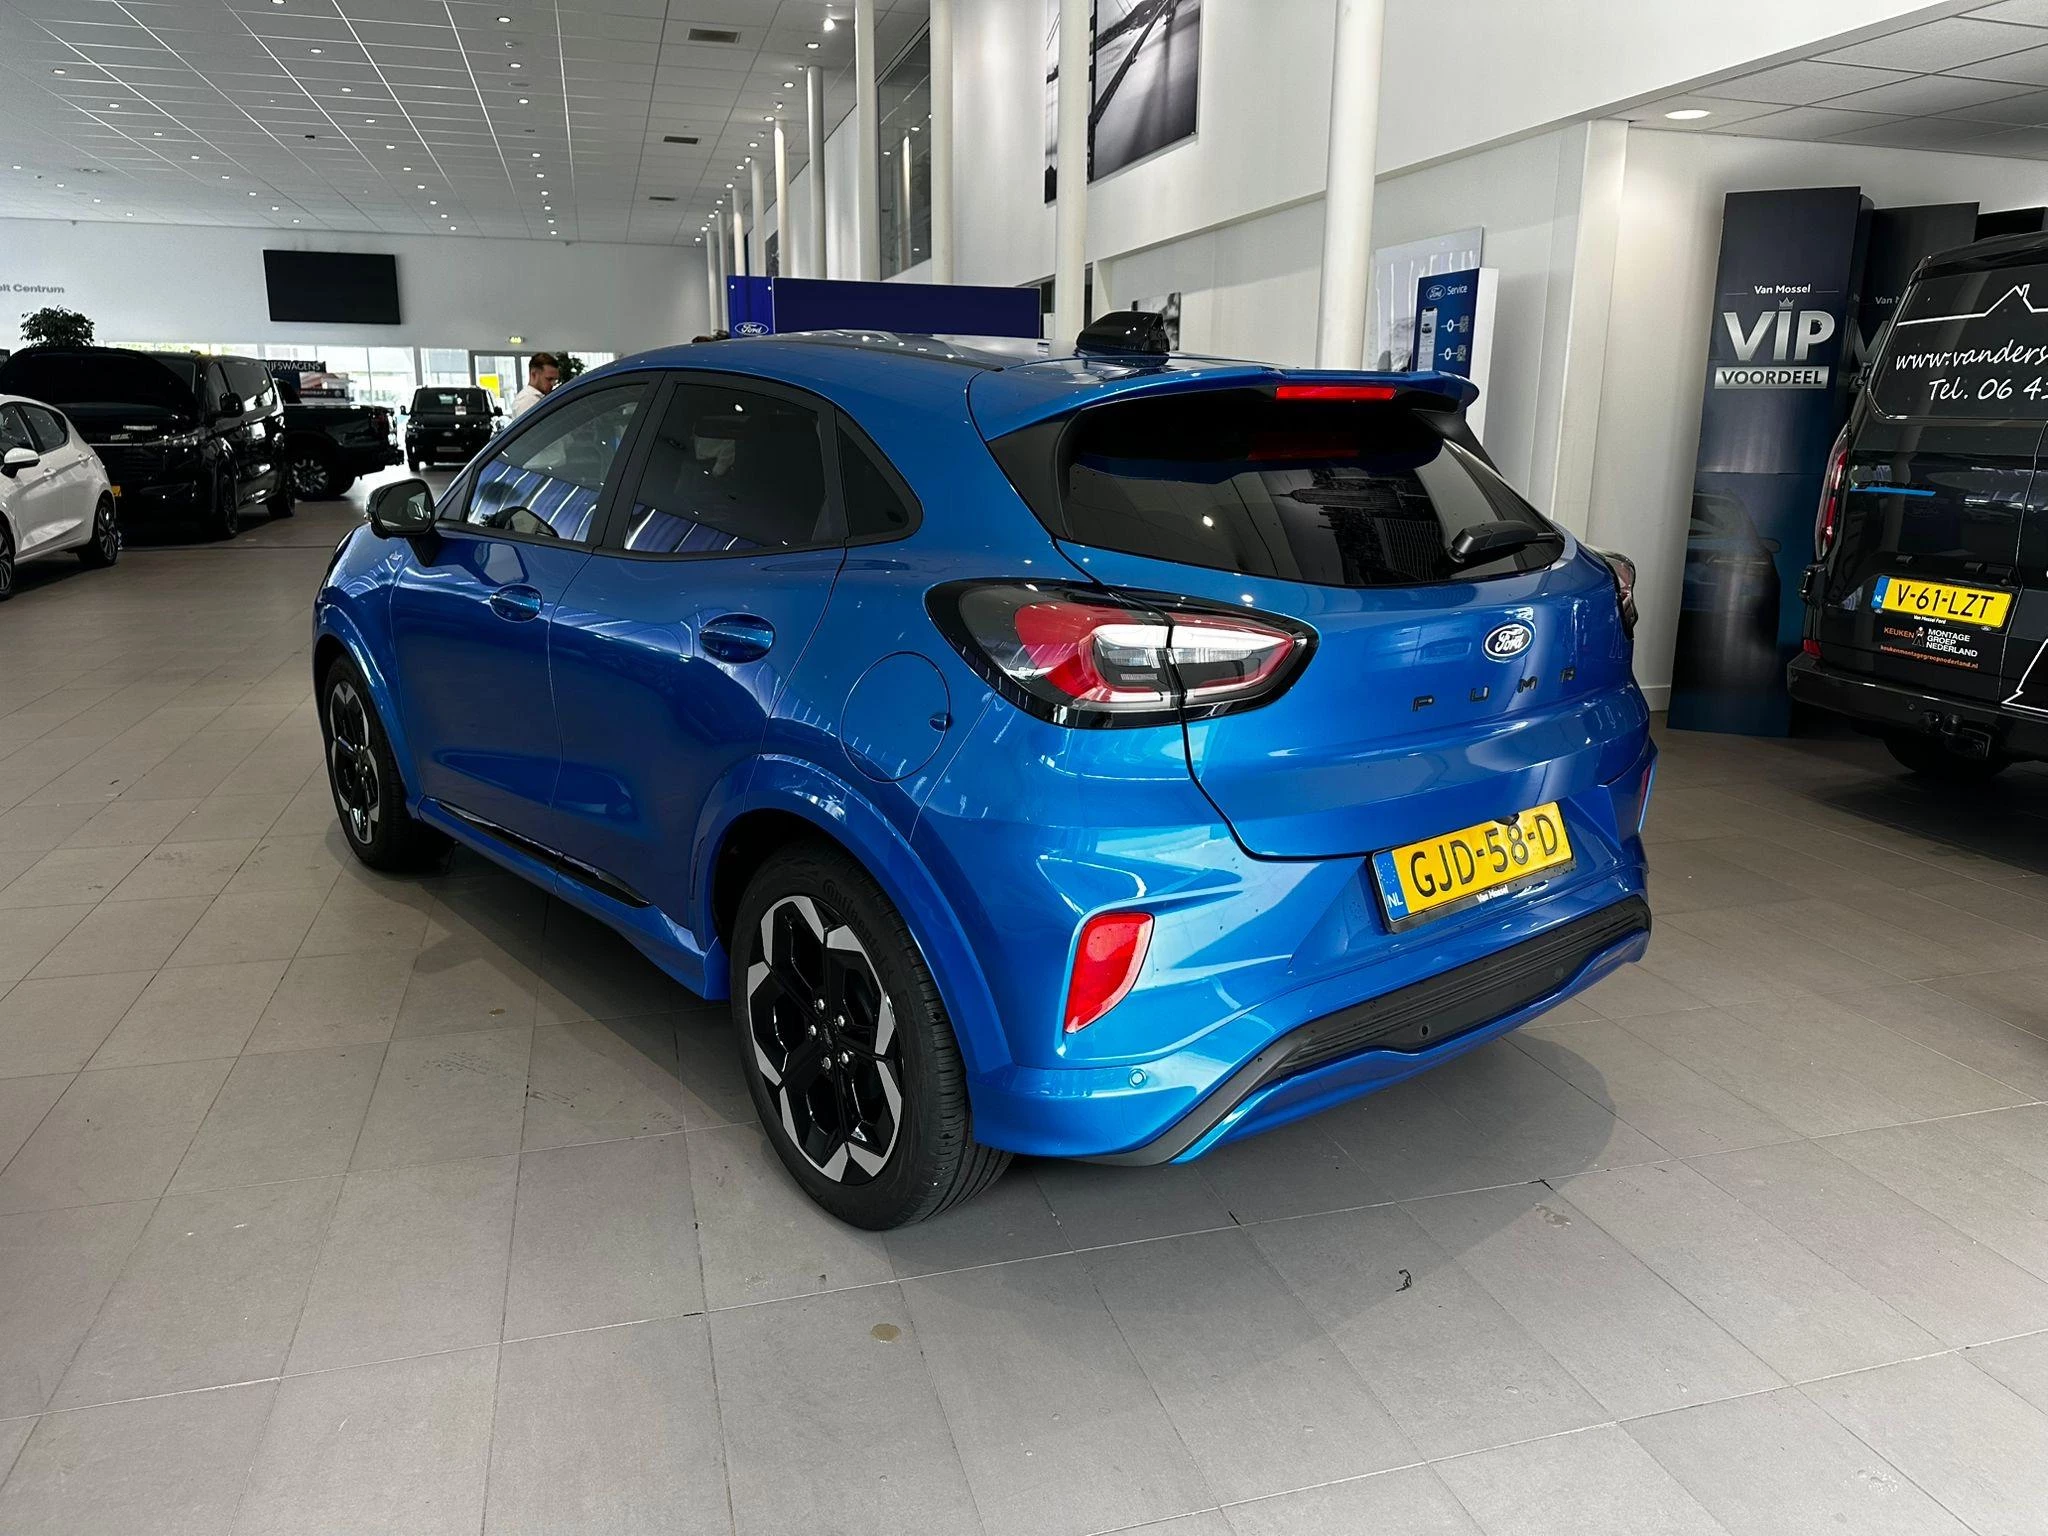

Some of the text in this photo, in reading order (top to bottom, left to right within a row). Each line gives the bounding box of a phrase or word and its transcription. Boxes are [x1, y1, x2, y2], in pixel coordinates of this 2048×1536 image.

[13, 284, 65, 293] Centrum
[1447, 285, 1468, 295] Service
[1754, 284, 1811, 295] Van Mossel
[1875, 297, 1892, 305] Van
[1723, 310, 1835, 361] VIP
[1722, 370, 1822, 385] VOORDEEL
[1928, 377, 1969, 400] Tel.
[1978, 378, 2013, 400] 06
[1874, 594, 1882, 603] NL
[1897, 584, 1994, 618] V-61-LZT
[1495, 627, 1524, 652] Ford
[1883, 627, 1915, 639] KEUKEN
[1927, 629, 1970, 642] MONTAGE
[1927, 637, 1957, 645] GROEP
[1926, 642, 1978, 657] NEDERLAND
[1410, 814, 1558, 897] GJD-58-D
[1387, 895, 1404, 911] NL
